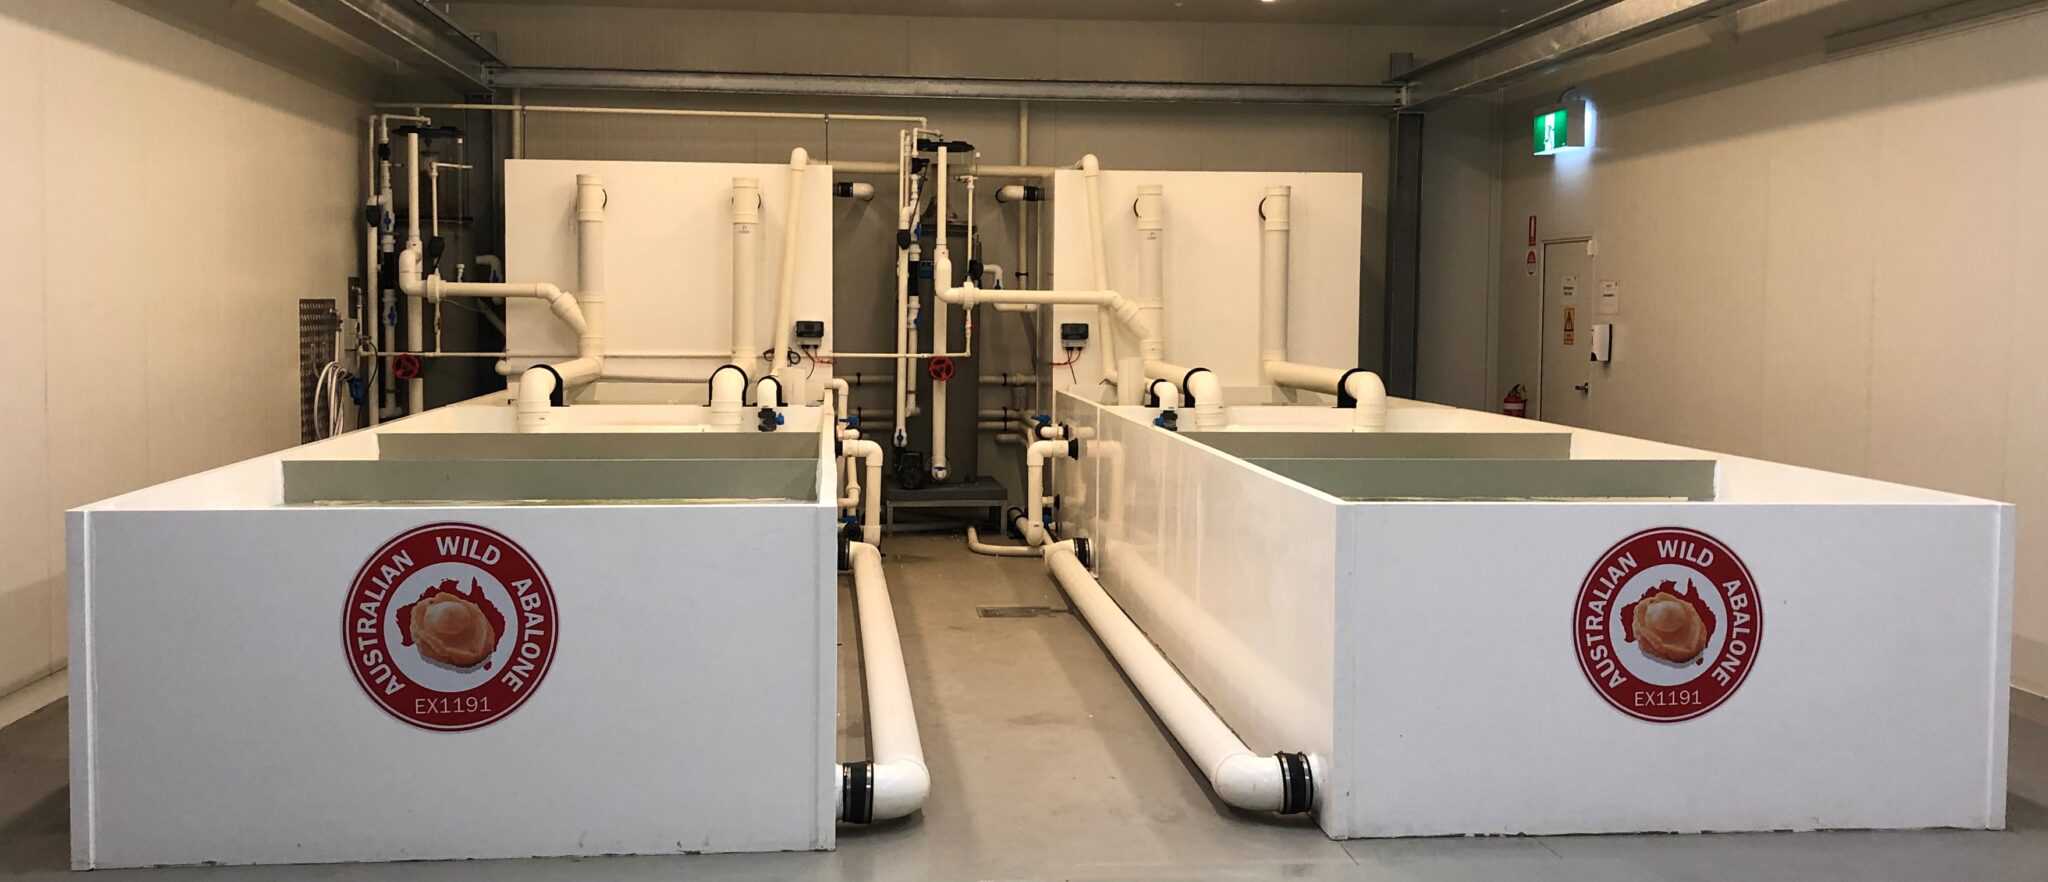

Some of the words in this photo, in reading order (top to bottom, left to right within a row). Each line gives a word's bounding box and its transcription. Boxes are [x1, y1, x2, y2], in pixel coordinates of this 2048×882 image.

[357, 550, 414, 695] AUSTRALIAN
[436, 536, 501, 565] WILD
[501, 578, 544, 692] ABALONE
[1586, 552, 1638, 688] AUSTRALIAN
[1657, 540, 1714, 567] WILD
[1712, 580, 1750, 687] ABALONE
[415, 696, 491, 714] EX1191
[1635, 690, 1701, 706] EX1191
